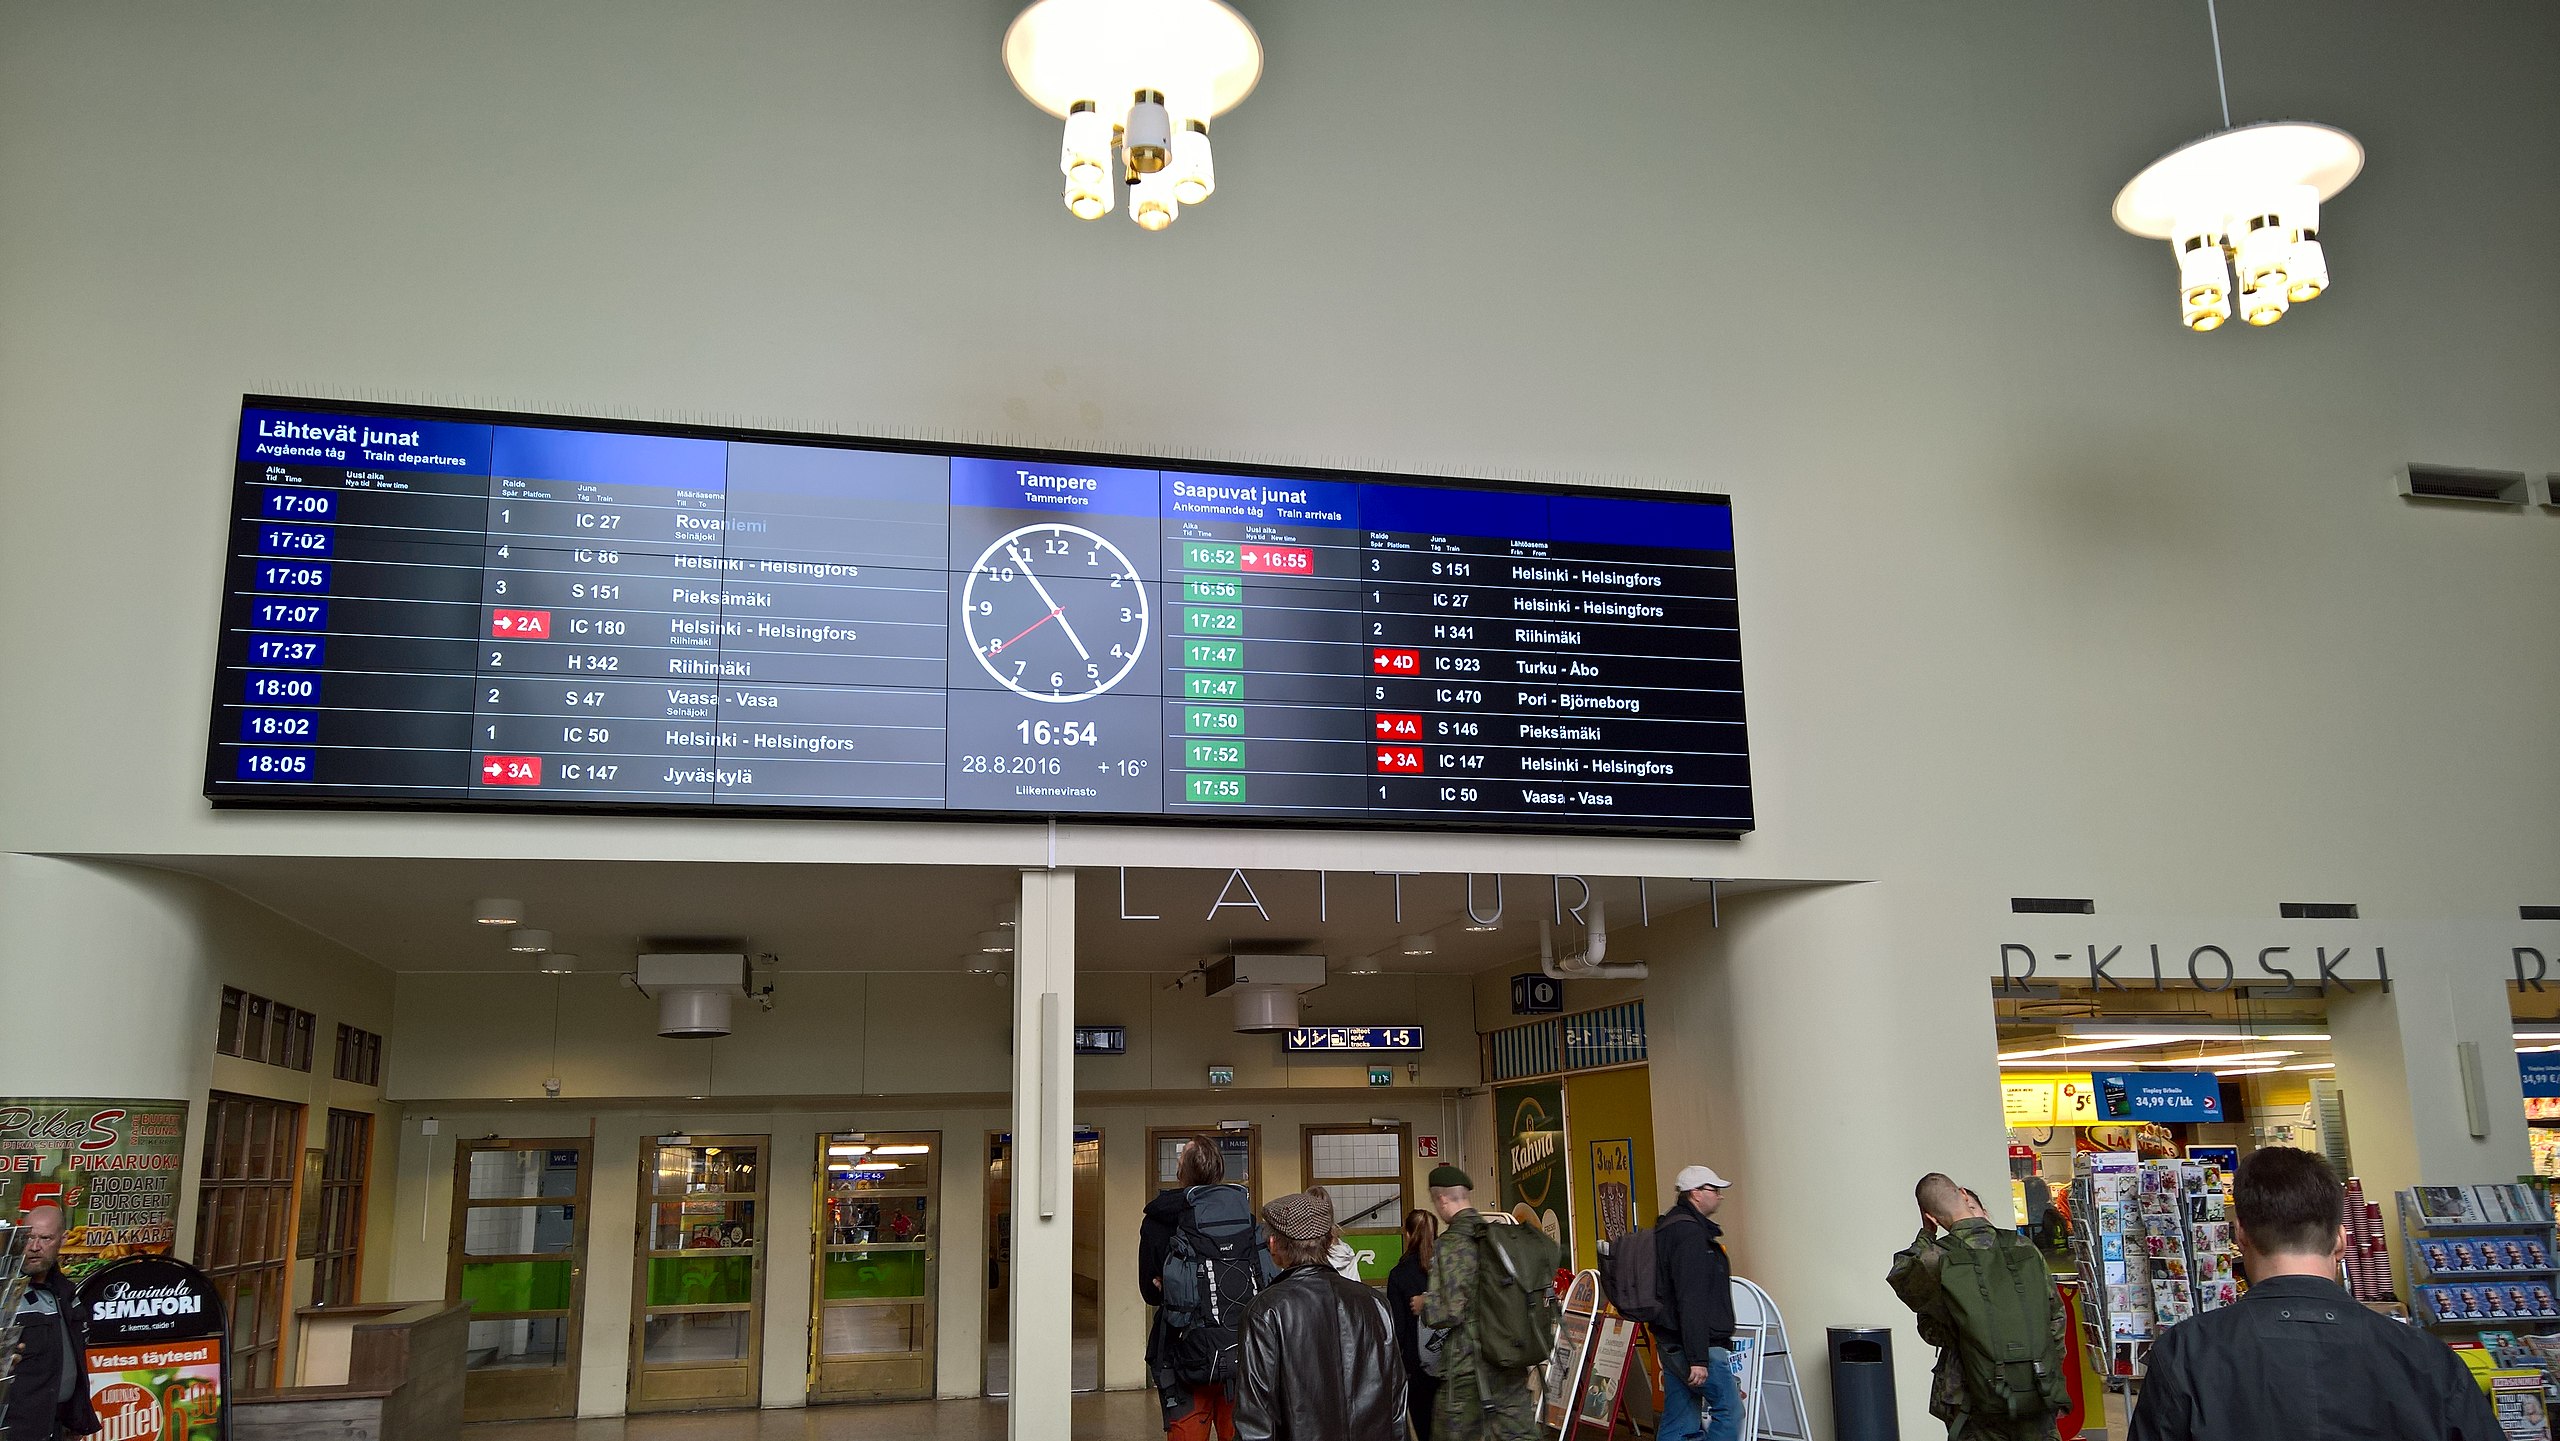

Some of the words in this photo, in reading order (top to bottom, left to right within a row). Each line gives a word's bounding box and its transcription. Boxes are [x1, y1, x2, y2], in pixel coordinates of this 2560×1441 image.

[260, 420, 356, 444] Lähtevät
[361, 427, 419, 447] junat
[257, 443, 322, 456] Avgående
[325, 448, 345, 460] tåg
[363, 450, 394, 461] Train
[399, 453, 466, 465] departures
[1017, 471, 1097, 492] Tampere
[677, 489, 725, 500] Määräasema
[1025, 491, 1088, 505] Tammerfors
[1174, 481, 1257, 503] Saapuvat
[1261, 488, 1306, 505] junat
[273, 496, 328, 513] 17:00
[1173, 502, 1244, 514] Ankommande
[1247, 506, 1263, 518] tåg
[502, 510, 509, 523] 1
[577, 514, 594, 527] IC
[600, 516, 620, 529] 27
[675, 512, 768, 536] Rovaniemi
[270, 532, 325, 549] 17:02
[675, 532, 715, 543] Seinäjoki
[498, 545, 509, 558] 4
[575, 549, 593, 562] IC
[596, 550, 620, 564] 86
[1191, 549, 1234, 564] 16:52
[1263, 553, 1306, 568] 16:55
[673, 553, 746, 572] Helsinki
[761, 559, 860, 578] Helsingfors
[1372, 559, 1380, 571] 3
[1432, 562, 1442, 574] S
[1447, 563, 1469, 576] 151
[267, 568, 322, 585] 17:05
[1513, 567, 1568, 581] Helsinki
[1582, 570, 1661, 587] Helsingfors
[496, 581, 506, 594] 3
[572, 584, 584, 597] S
[591, 585, 618, 599] 151
[1189, 581, 1236, 596] 16:56
[673, 587, 770, 608] Pieksämäki
[1373, 591, 1379, 603] 1
[1434, 594, 1448, 606] IC
[1453, 595, 1468, 607] 27
[263, 606, 319, 622] 17:07
[1514, 598, 1570, 612] Helsinki
[1584, 601, 1663, 618] Helsingfors
[517, 617, 542, 631] 2A
[571, 620, 588, 633] IC
[595, 621, 625, 634] 180
[1192, 614, 1235, 628] 17:22
[671, 618, 740, 638] Helsinki
[759, 623, 856, 642] Helsingfors
[1374, 623, 1382, 635] 2
[1435, 625, 1444, 638] H
[1450, 626, 1473, 639] 341
[1516, 629, 1580, 644] Riihimäki
[260, 642, 316, 659] 17:37
[1192, 647, 1236, 661] 17:47
[491, 652, 502, 666] 2
[569, 655, 580, 669] H
[587, 656, 618, 670] 342
[1393, 656, 1413, 668] 4D
[1436, 657, 1450, 670] IC
[1455, 658, 1480, 671] 923
[670, 658, 750, 676] Riihimäki
[1516, 661, 1556, 674] Turku
[1570, 661, 1598, 676] Åbo
[256, 680, 312, 696] 18:00
[1192, 680, 1236, 694] 17:47
[1376, 687, 1384, 699] 5
[488, 689, 499, 702] 2
[566, 692, 578, 705] S
[583, 692, 604, 706] 47
[668, 689, 719, 708] Vaasa
[737, 692, 777, 707] Vasa
[1437, 689, 1451, 702] IC
[1456, 690, 1481, 703] 470
[1518, 693, 1546, 706] Pori
[1561, 694, 1639, 712] Björneborg
[252, 718, 308, 734] 18:02
[1193, 713, 1237, 728] 17:50
[1396, 720, 1416, 733] 4A
[488, 726, 494, 739] 1
[564, 728, 582, 742] IC
[588, 729, 608, 742] 50
[1018, 720, 1097, 746] 16:54
[1439, 722, 1448, 734] S
[1453, 722, 1478, 735] 146
[1520, 725, 1600, 740] Pieksämäki
[666, 731, 736, 746] Helsinki
[755, 734, 853, 752] Helsingfors
[1193, 747, 1238, 761] 17:52
[1397, 753, 1417, 766] 3A
[1440, 754, 1454, 767] IC
[1460, 755, 1484, 768] 147
[249, 756, 305, 772] 18:05
[508, 764, 532, 778] 3A
[962, 756, 1060, 774] 28.8.2016
[1118, 760, 1147, 776] 16°
[1522, 757, 1578, 771] Helsinki
[1592, 760, 1673, 776] Helsingfors
[562, 765, 580, 779] IC
[587, 766, 618, 780] 147
[664, 768, 752, 786] Jyväskylä
[1194, 781, 1238, 795] 17:55
[1380, 786, 1385, 799] 1
[1441, 788, 1456, 800] IC
[1461, 788, 1477, 801] 50
[1522, 790, 1565, 803] Vaasa
[1578, 792, 1612, 805] Vasa
[1119, 866, 1733, 928] LAITURIT
[2000, 943, 2392, 996] R-KIOSKI
[1383, 1030, 1410, 1046] 1-5
[2136, 1096, 2165, 1109] 34,99
[2167, 1096, 2194, 1108] €/kk
[68, 1153, 180, 1172] PIKARUOKA
[92, 1176, 168, 1194] HODARIT
[89, 1194, 173, 1211] BURGERIT
[87, 1211, 166, 1229] LIHIKSET
[86, 1227, 175, 1248] MAKKARAT
[104, 1279, 192, 1301] Ravintola
[93, 1295, 201, 1321] SEMAFORI
[90, 1355, 138, 1368] Vatsa
[142, 1348, 208, 1367] täyteen!
